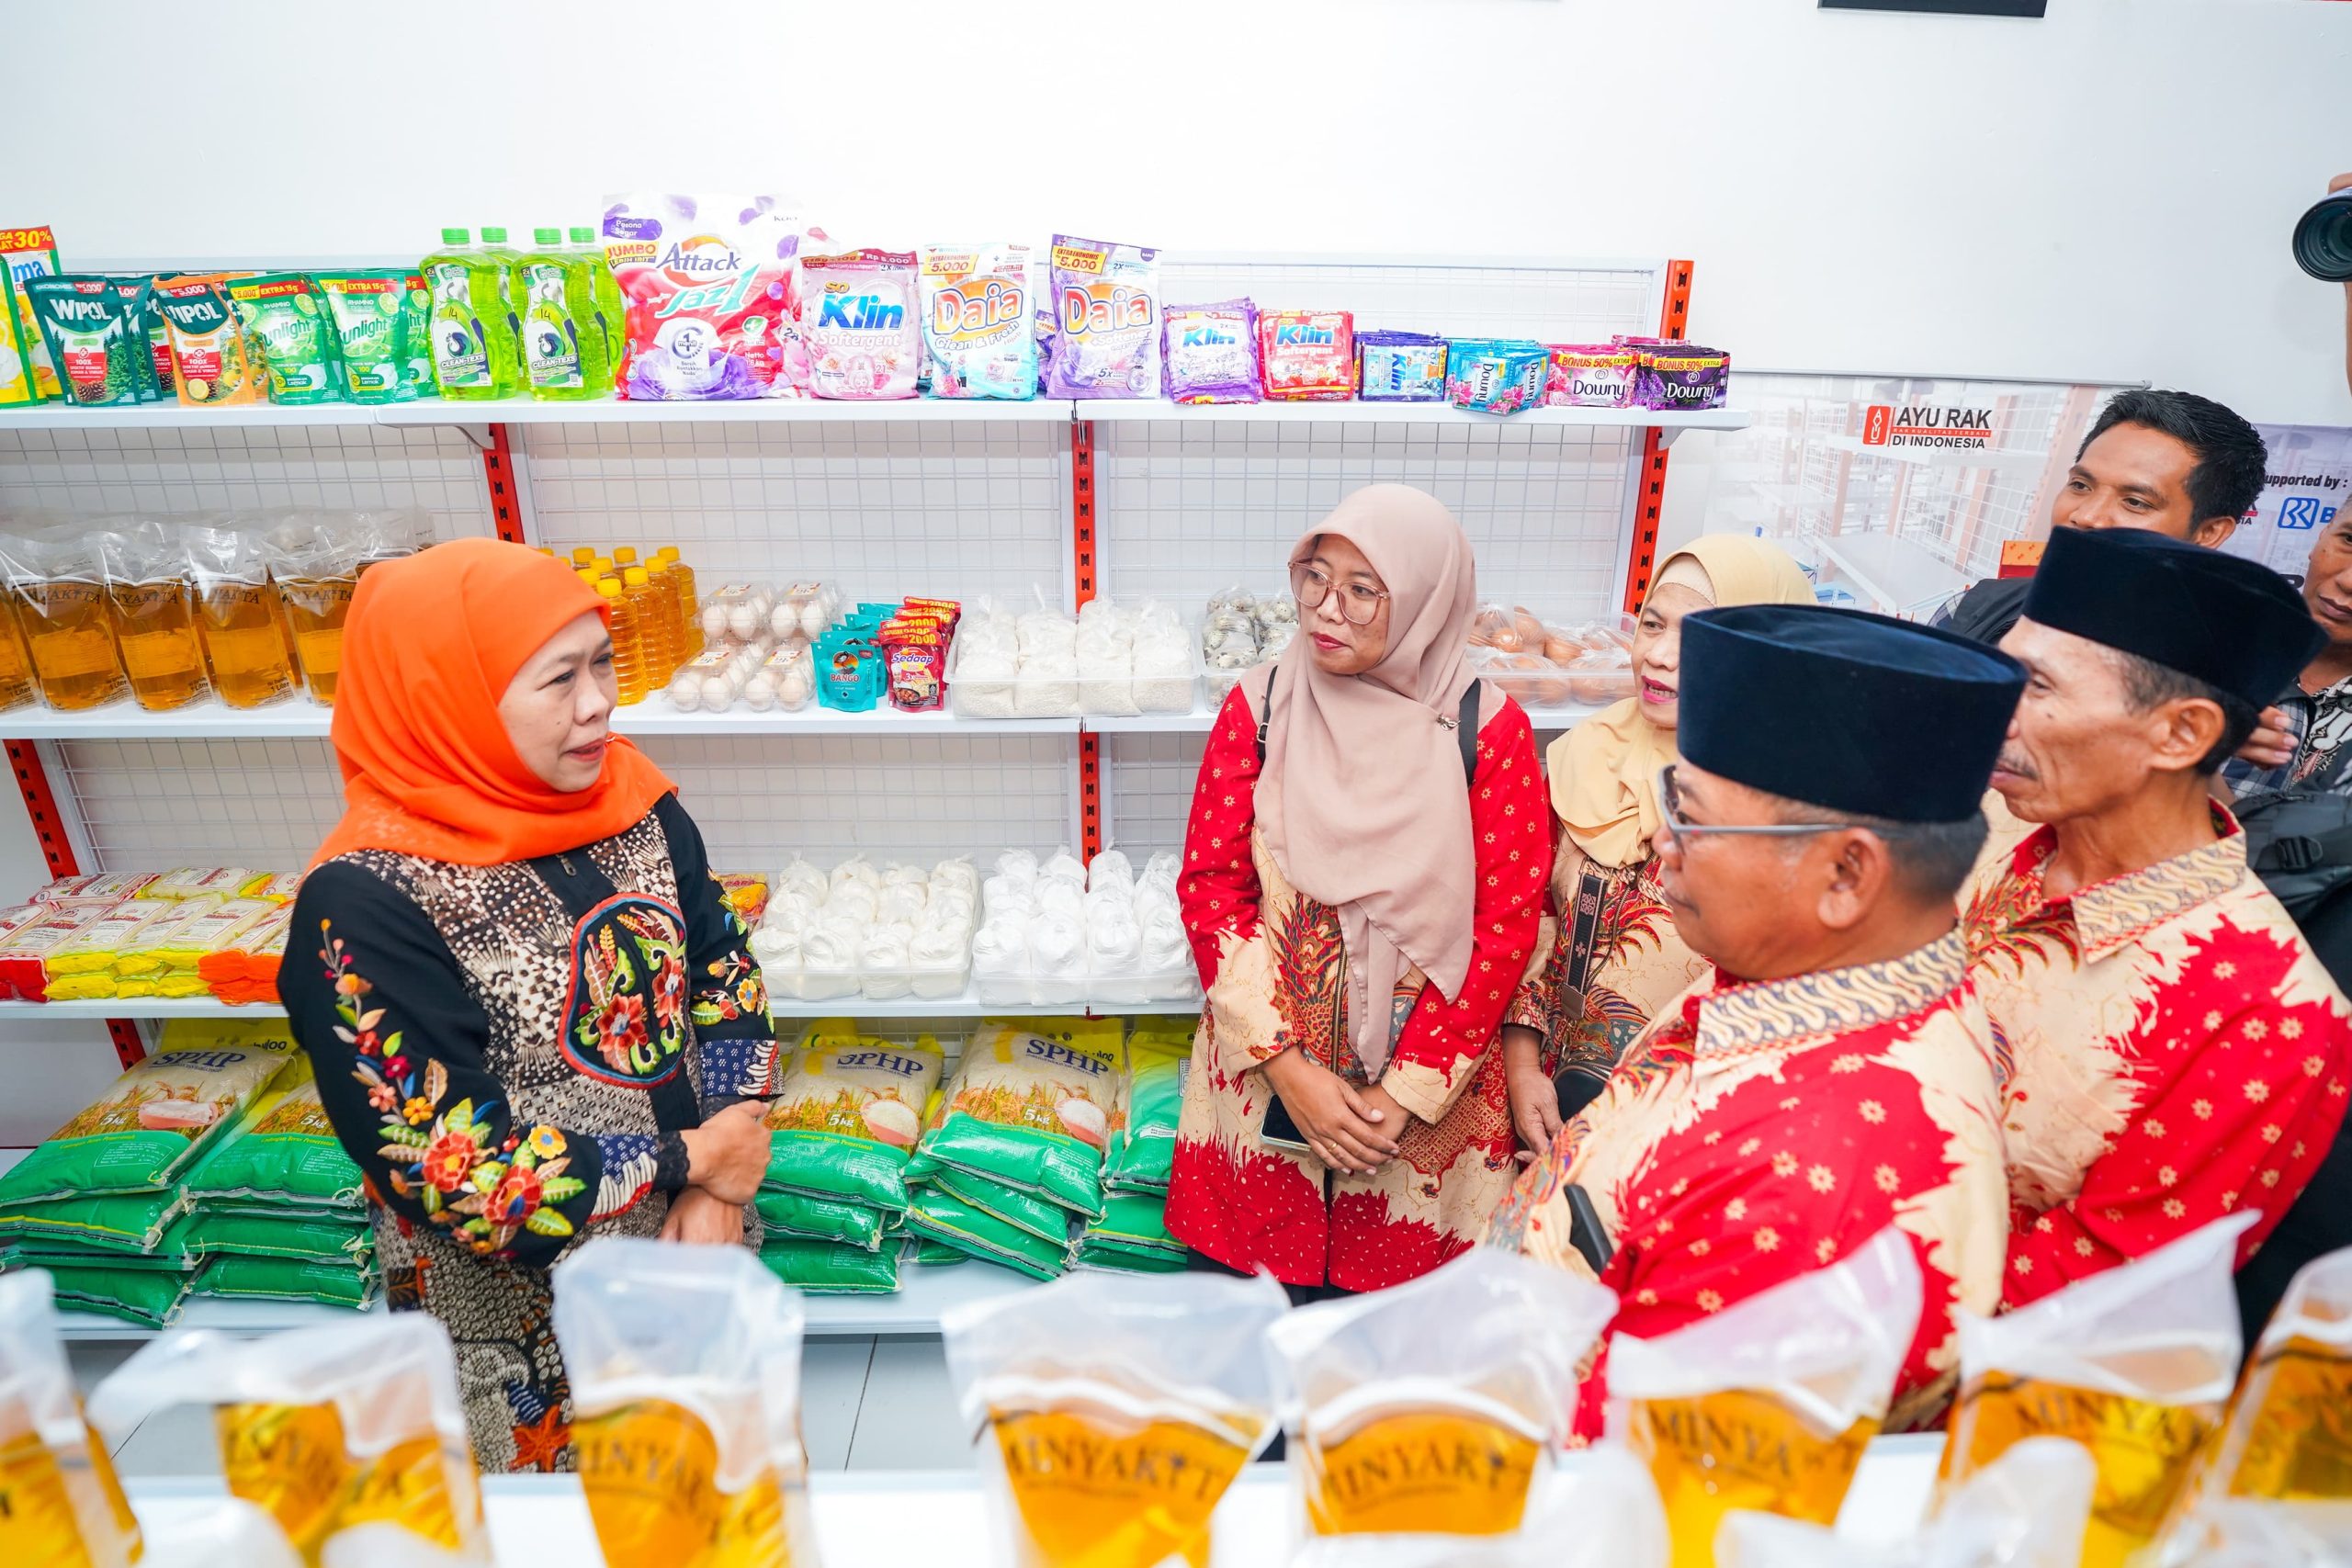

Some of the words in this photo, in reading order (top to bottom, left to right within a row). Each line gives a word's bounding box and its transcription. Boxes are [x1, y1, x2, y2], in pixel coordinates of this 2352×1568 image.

[14, 230, 52, 249] 30%
[607, 243, 657, 259] JUMBO
[656, 242, 742, 271] Attack
[1057, 248, 1075, 256] EXTRA
[1059, 256, 1097, 271] 5.000
[261, 286, 284, 295] EXTRA
[49, 299, 112, 320] WIPOL
[818, 294, 904, 330] Klin
[933, 283, 1022, 334] Daia
[1064, 287, 1152, 334] Daia
[263, 318, 311, 347] unlight
[819, 332, 901, 350] Softergent
[935, 337, 972, 350] Clean
[976, 337, 986, 348] &
[989, 321, 1020, 343] Fresh
[1182, 327, 1236, 348] Klin
[1276, 325, 1333, 344] Klin
[1391, 353, 1407, 390] Klin
[1562, 356, 1591, 367] BONUS
[1593, 356, 1613, 367] 50%
[1657, 358, 1685, 370] BONUS
[1686, 358, 1703, 370] 50%
[1475, 363, 1494, 402] Downy
[1524, 361, 1540, 402] Downy
[1573, 379, 1626, 400] Downy
[1667, 382, 1715, 402] Downy
[1896, 407, 1940, 427] AYU
[1946, 409, 1992, 429] RAK
[1893, 435, 1906, 446] DI
[1910, 436, 1984, 449] INDONESIA
[2264, 475, 2324, 488] upported
[2324, 476, 2341, 491] by
[909, 633, 936, 645] 2000
[892, 652, 933, 664] Sedaap
[830, 673, 860, 682] BANGO
[153, 1051, 246, 1068] SPHP
[838, 1052, 923, 1076] SPHP
[1026, 1039, 1109, 1076] SPHP
